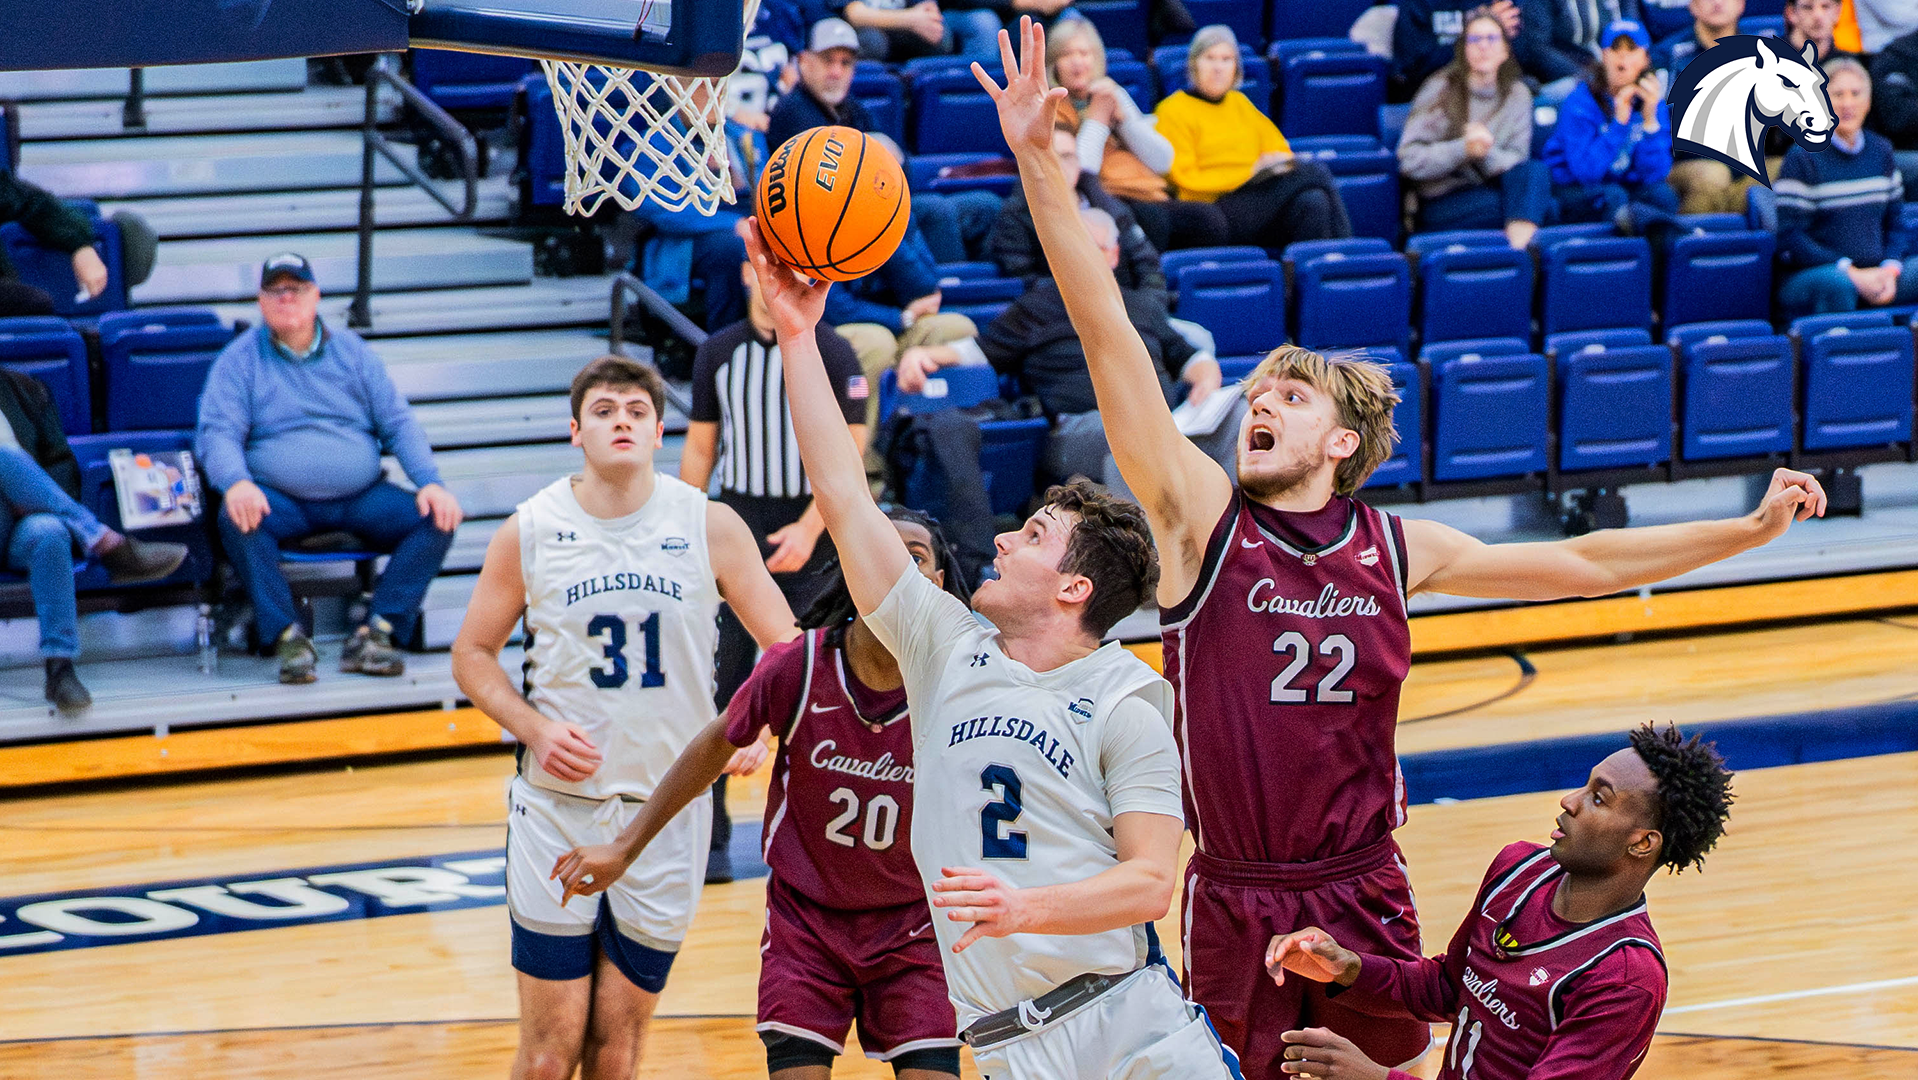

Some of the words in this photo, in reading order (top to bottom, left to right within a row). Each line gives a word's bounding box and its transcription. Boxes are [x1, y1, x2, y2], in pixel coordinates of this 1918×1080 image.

[815, 137, 845, 192] EVO
[566, 572, 683, 607] HILLSDALE
[1247, 577, 1381, 618] Cavaliers
[587, 611, 666, 689] 31
[1270, 630, 1356, 704] 22
[810, 738, 915, 783] Cavalier
[948, 715, 1075, 780] HILLSDALE
[825, 786, 900, 851] 20
[977, 761, 1030, 861] 2
[1463, 946, 1521, 1030] avaliers
[1450, 1004, 1483, 1080] 11
